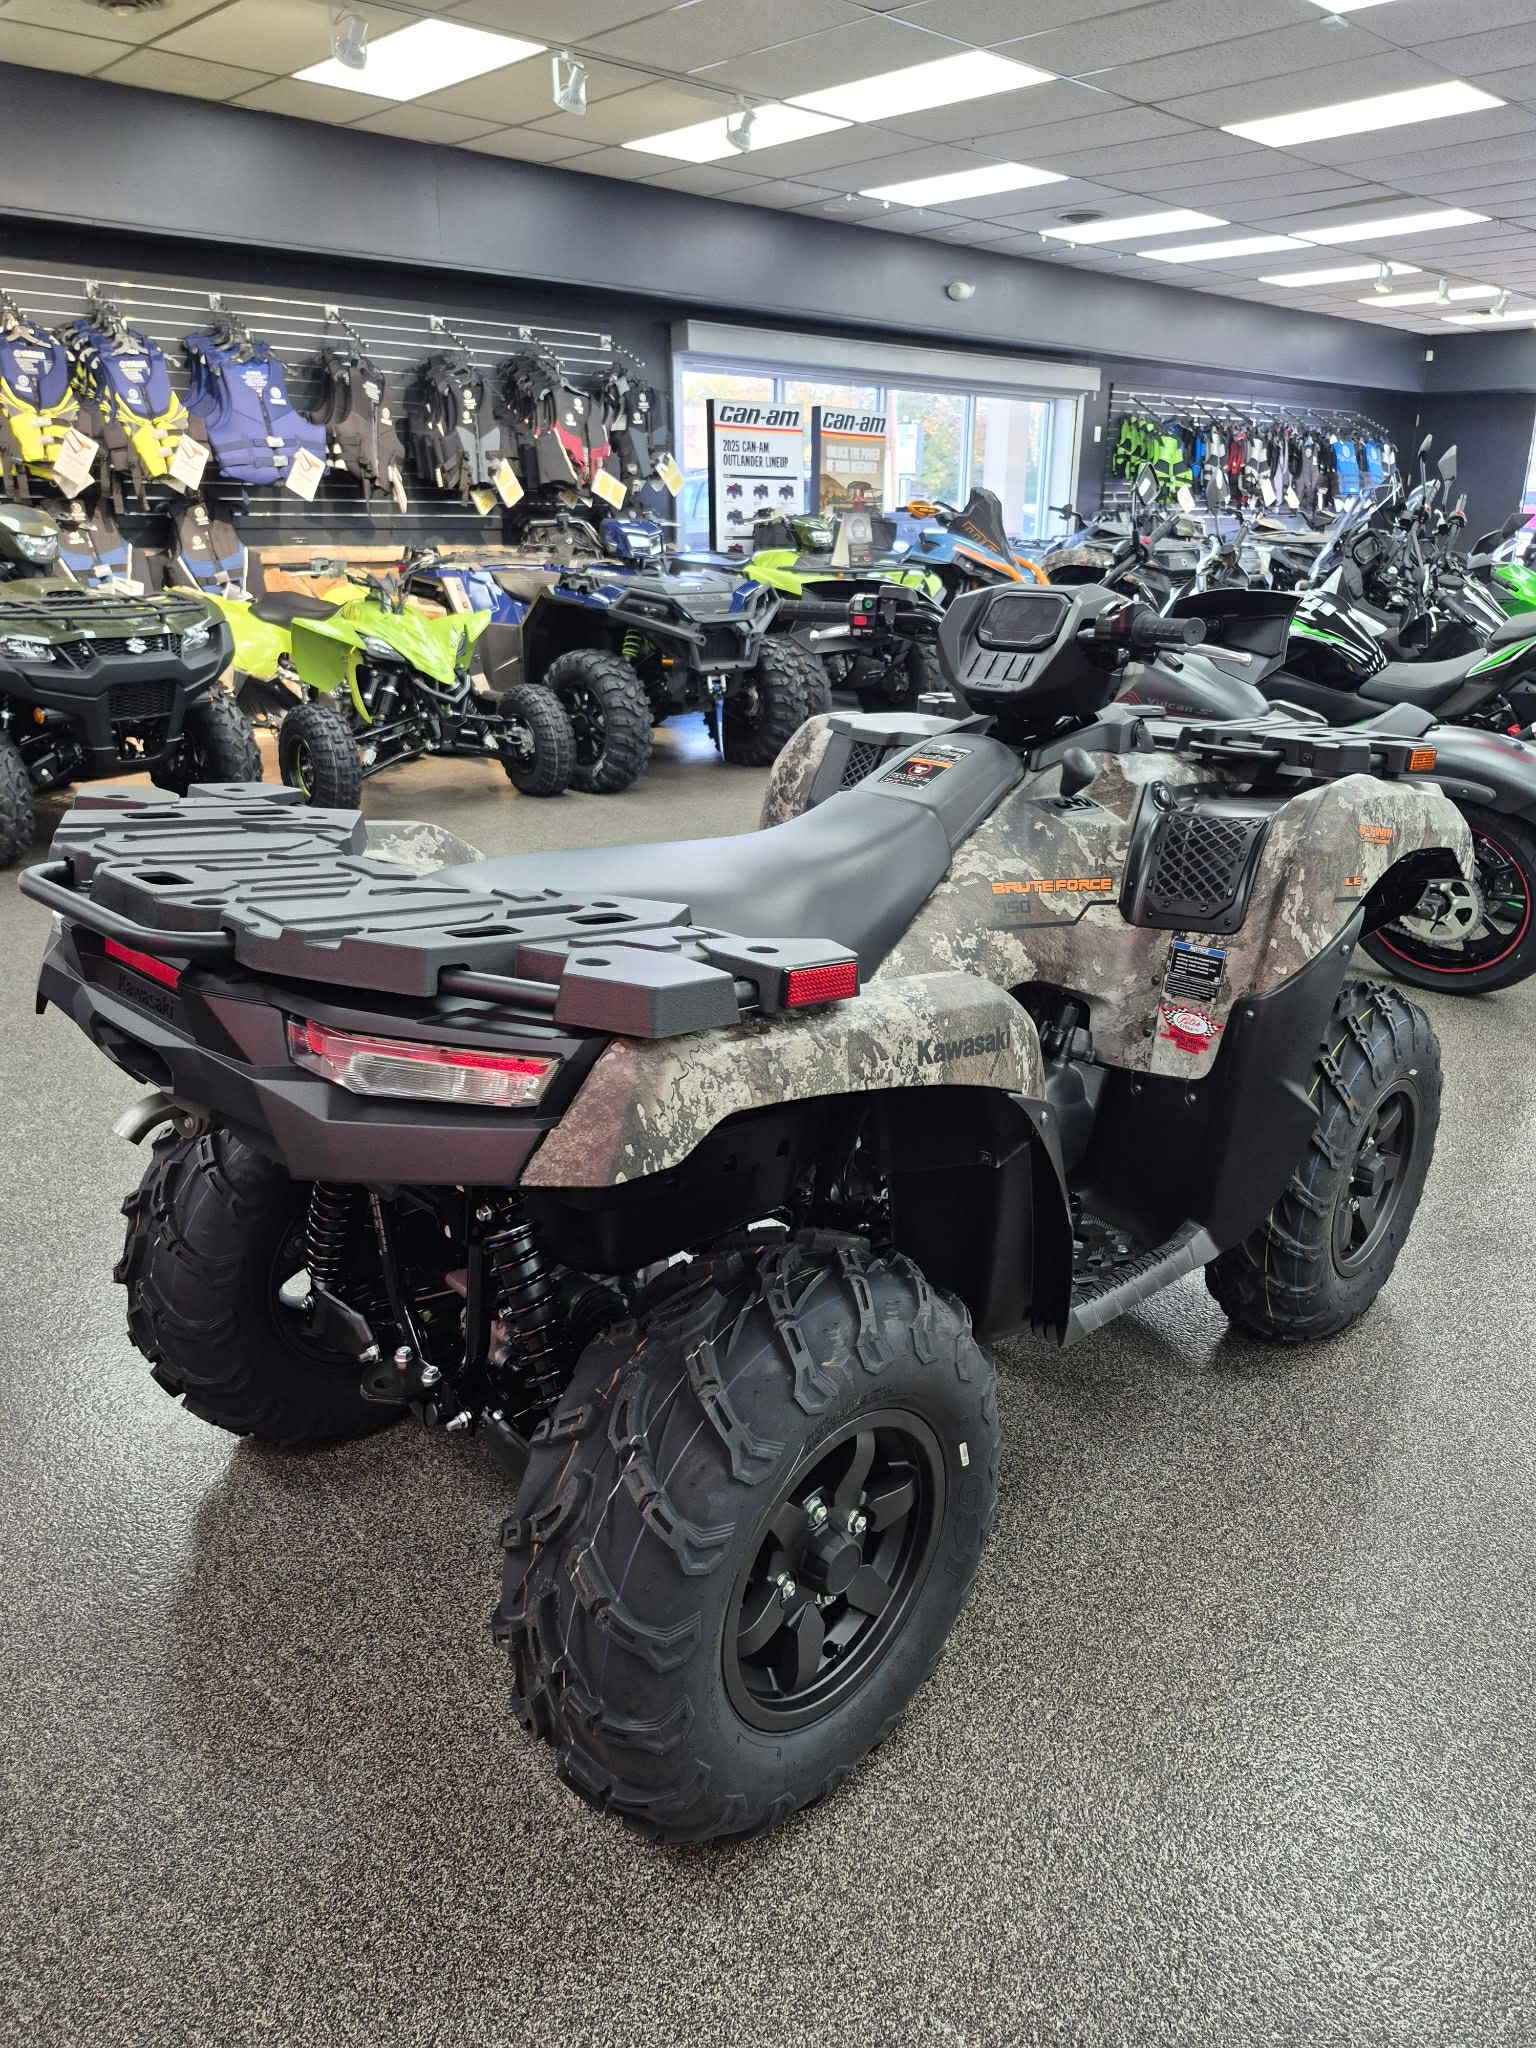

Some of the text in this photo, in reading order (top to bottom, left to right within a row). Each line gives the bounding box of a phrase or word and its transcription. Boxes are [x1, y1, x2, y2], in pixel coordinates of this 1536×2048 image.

[719, 405, 800, 427] can-am
[823, 412, 886, 433] can-am
[723, 439, 769, 454] 2025 CAN-AM
[723, 454, 789, 469] OUTLANDER LINEUP
[1147, 697, 1193, 713] Vulcan
[992, 878, 1113, 895] BRUTE FORCE
[1344, 877, 1360, 887] LE
[918, 1025, 1011, 1066] Kawasaki
